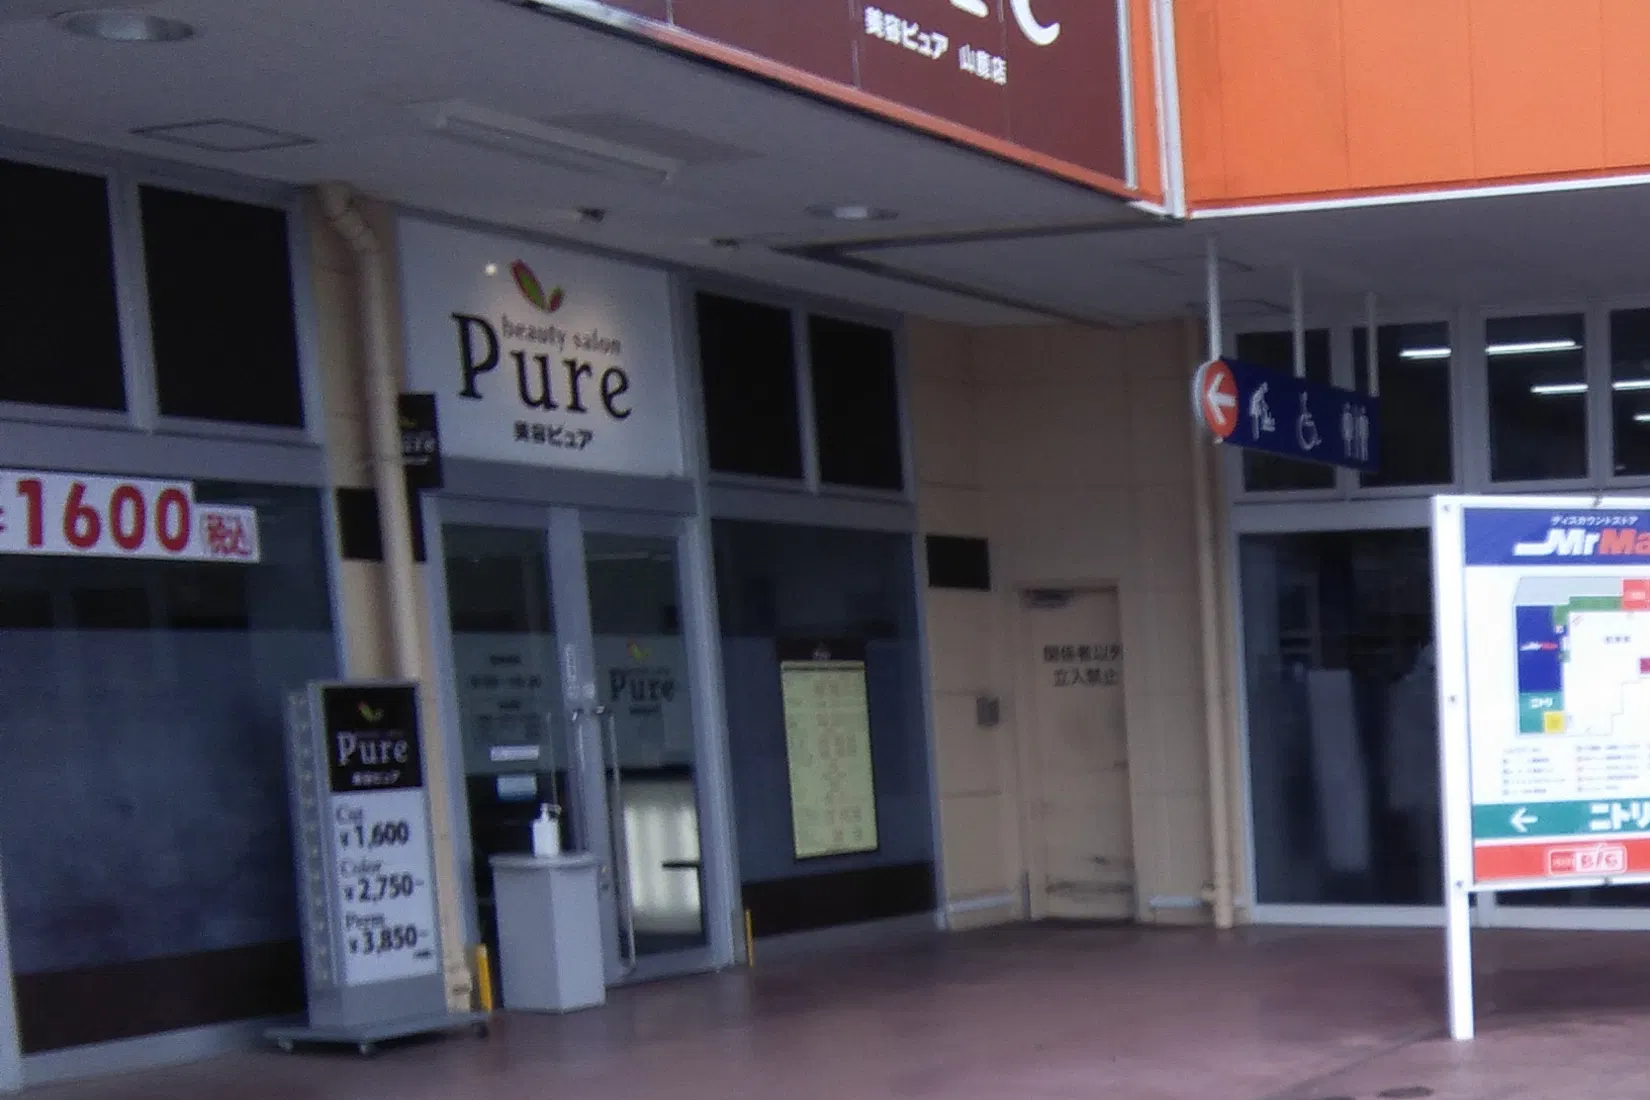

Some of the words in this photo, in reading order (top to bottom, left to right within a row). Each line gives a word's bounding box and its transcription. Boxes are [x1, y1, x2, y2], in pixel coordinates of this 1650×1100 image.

[864, 6, 949, 59] 美容ピュア
[502, 314, 566, 352] beauty
[572, 328, 621, 354] salon
[451, 312, 632, 419] Pure
[0, 478, 191, 553] 1600
[336, 731, 408, 767] Pure
